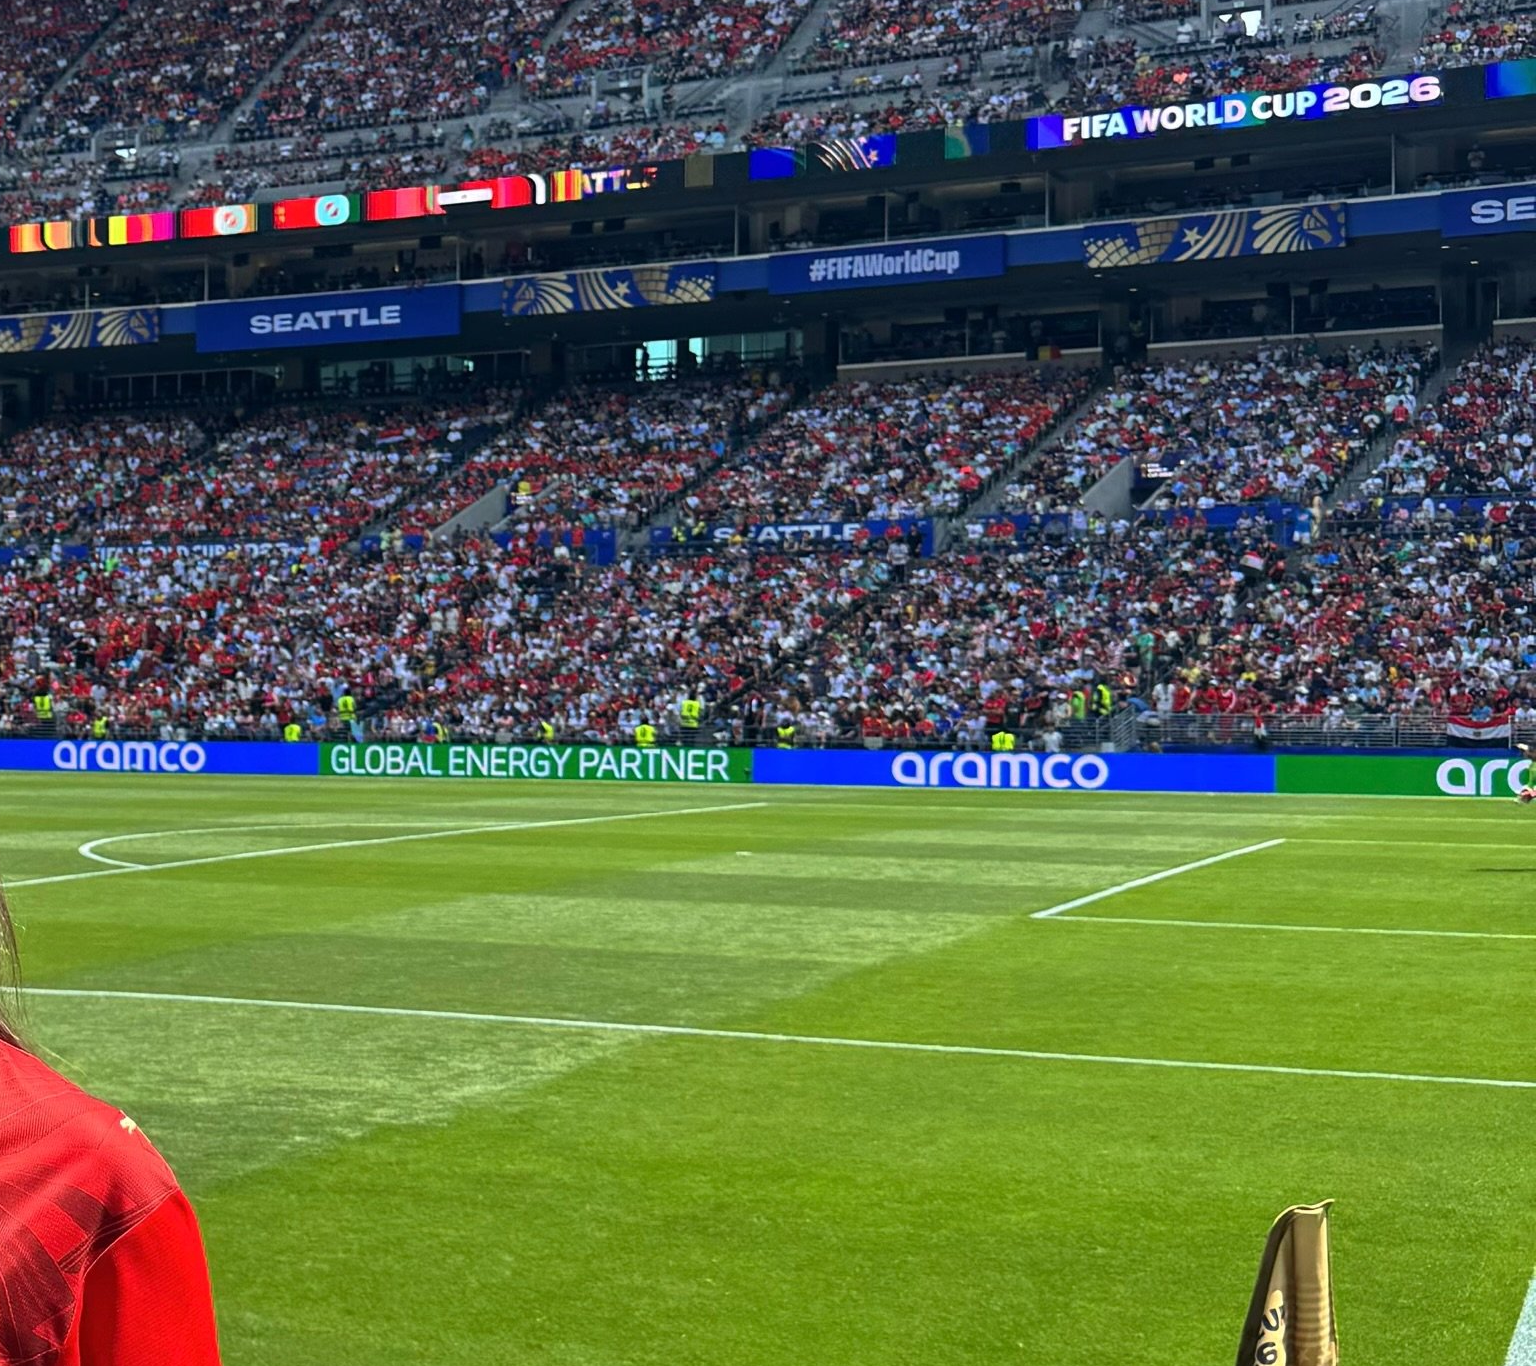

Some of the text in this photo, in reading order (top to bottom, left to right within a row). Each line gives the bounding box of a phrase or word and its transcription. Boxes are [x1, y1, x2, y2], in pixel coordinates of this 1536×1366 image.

[1063, 75, 1441, 141] FIFA WORLD CUP 2026
[1471, 196, 1536, 224] SE
[809, 248, 961, 282] #FIFAWorldCup
[249, 305, 401, 335] SEATTLE
[52, 740, 207, 773] aramco
[330, 744, 729, 781] GLOBAL ENERGY PARTNER
[891, 751, 1109, 789] aramco
